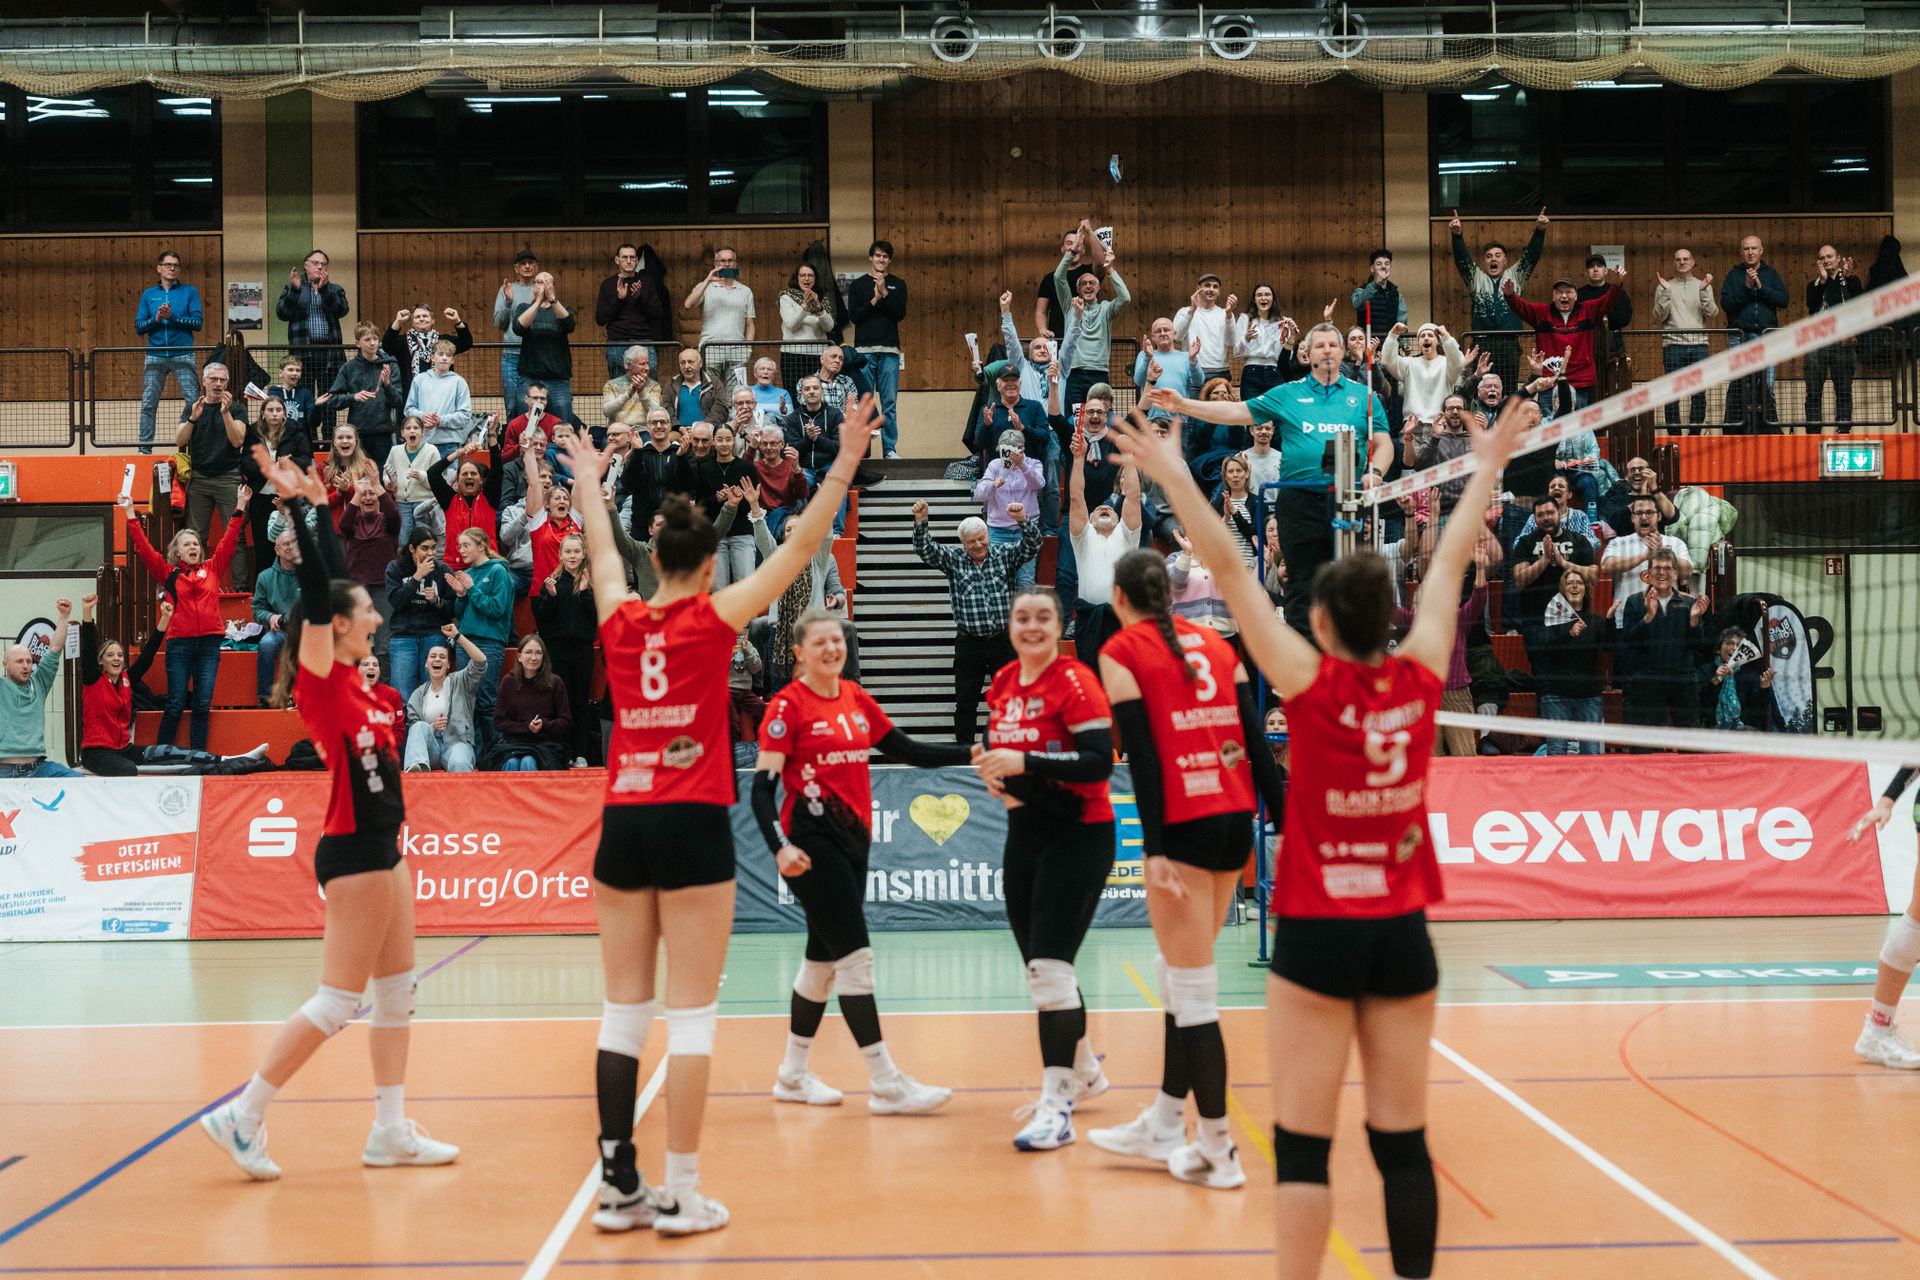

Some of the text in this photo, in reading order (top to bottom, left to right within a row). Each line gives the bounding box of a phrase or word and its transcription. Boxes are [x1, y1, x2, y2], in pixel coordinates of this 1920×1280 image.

[31, 634, 49, 651] BLAC
[640, 650, 668, 700] 8
[1184, 651, 1217, 702] 3
[837, 713, 853, 741] 1
[817, 750, 870, 765] Lexwa
[1364, 730, 1411, 787] 9
[872, 800, 900, 843] ir
[1428, 806, 1813, 864] Lexware
[118, 841, 160, 858] JETZT
[397, 826, 500, 856] kasse
[97, 856, 182, 877] ERFRISCHEN!
[1109, 866, 1143, 877] EDE
[318, 869, 595, 907] burg/Orte
[1646, 967, 1879, 979] DEKRA
